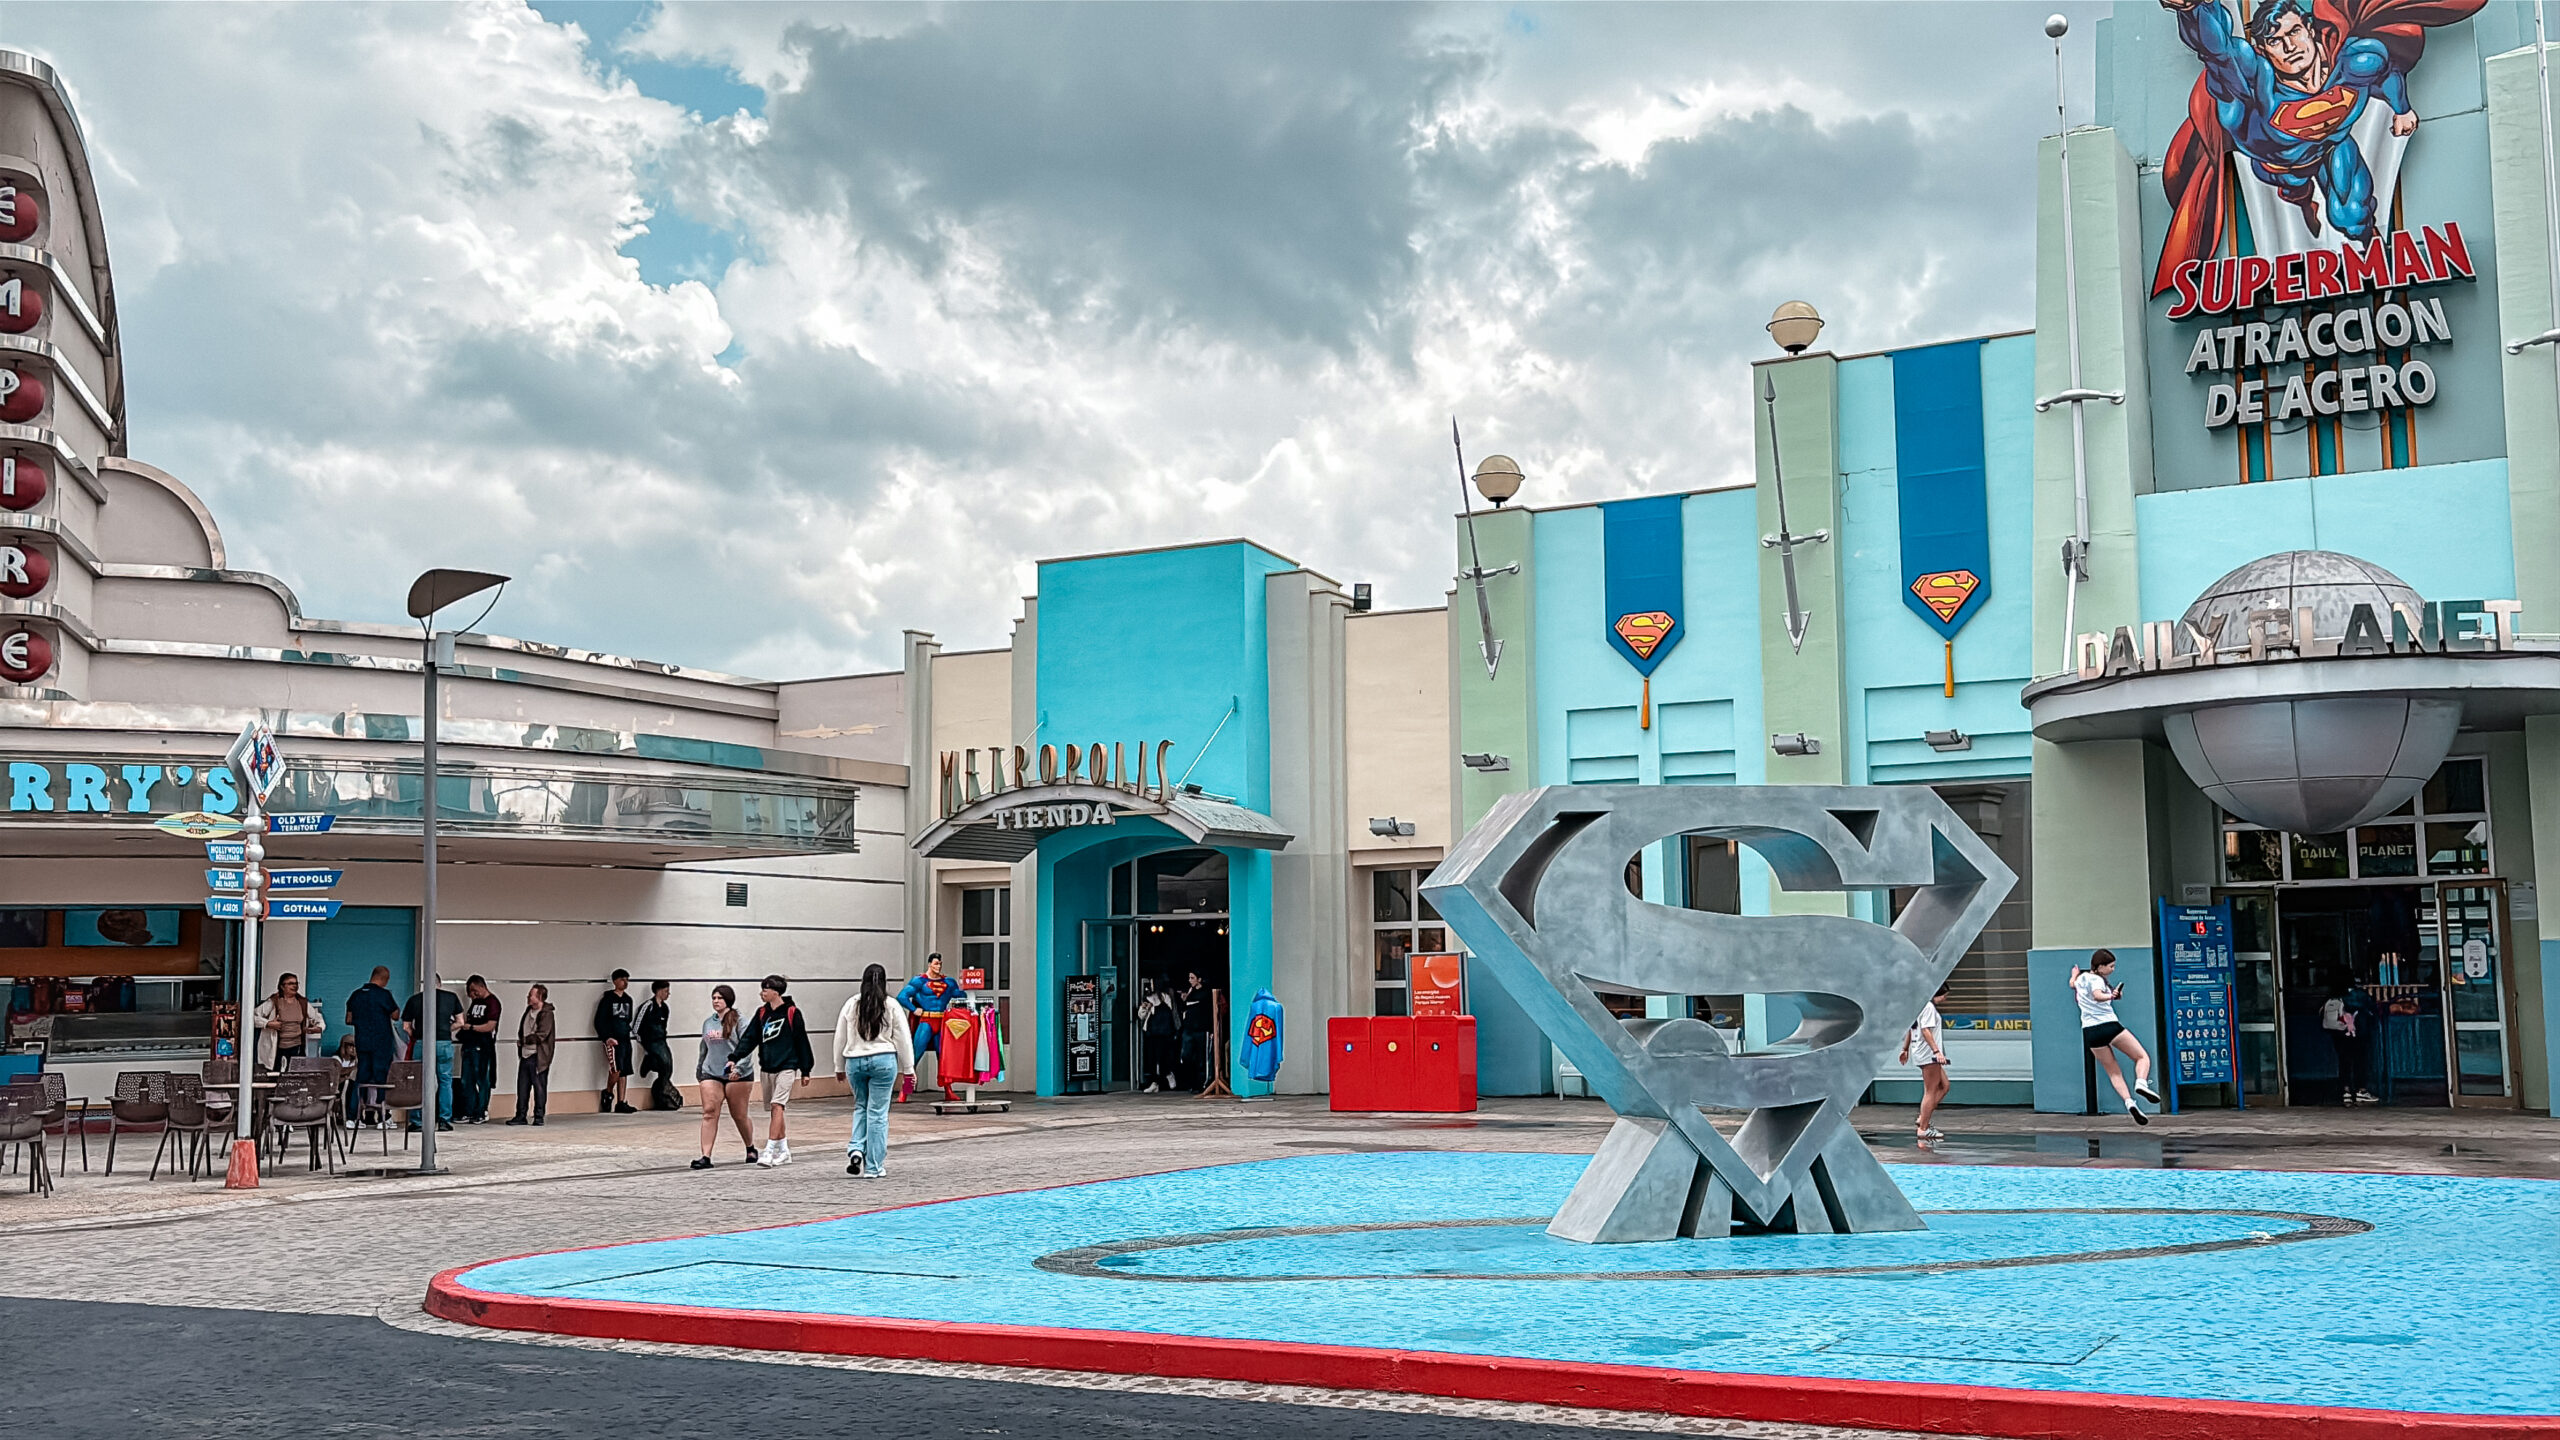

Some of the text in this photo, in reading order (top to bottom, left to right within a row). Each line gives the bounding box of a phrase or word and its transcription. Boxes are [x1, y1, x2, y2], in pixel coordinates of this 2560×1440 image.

[2166, 221, 2476, 320] SUPERMAN
[2185, 292, 2452, 374] ATRACCIÓN
[2205, 361, 2438, 430] DE ACERO
[2076, 600, 2523, 681] DAILY PLANET
[940, 740, 1175, 819] METROPOLIS
[277, 815, 322, 825] OLD WEST
[992, 802, 1116, 830] TIENDA
[280, 824, 319, 832] TERRITORY
[210, 845, 244, 855] HOLLYWOOD
[2300, 844, 2414, 859] DAILY PLANET
[271, 874, 333, 885] METROPOLIS
[283, 904, 327, 914] GOTHAM
